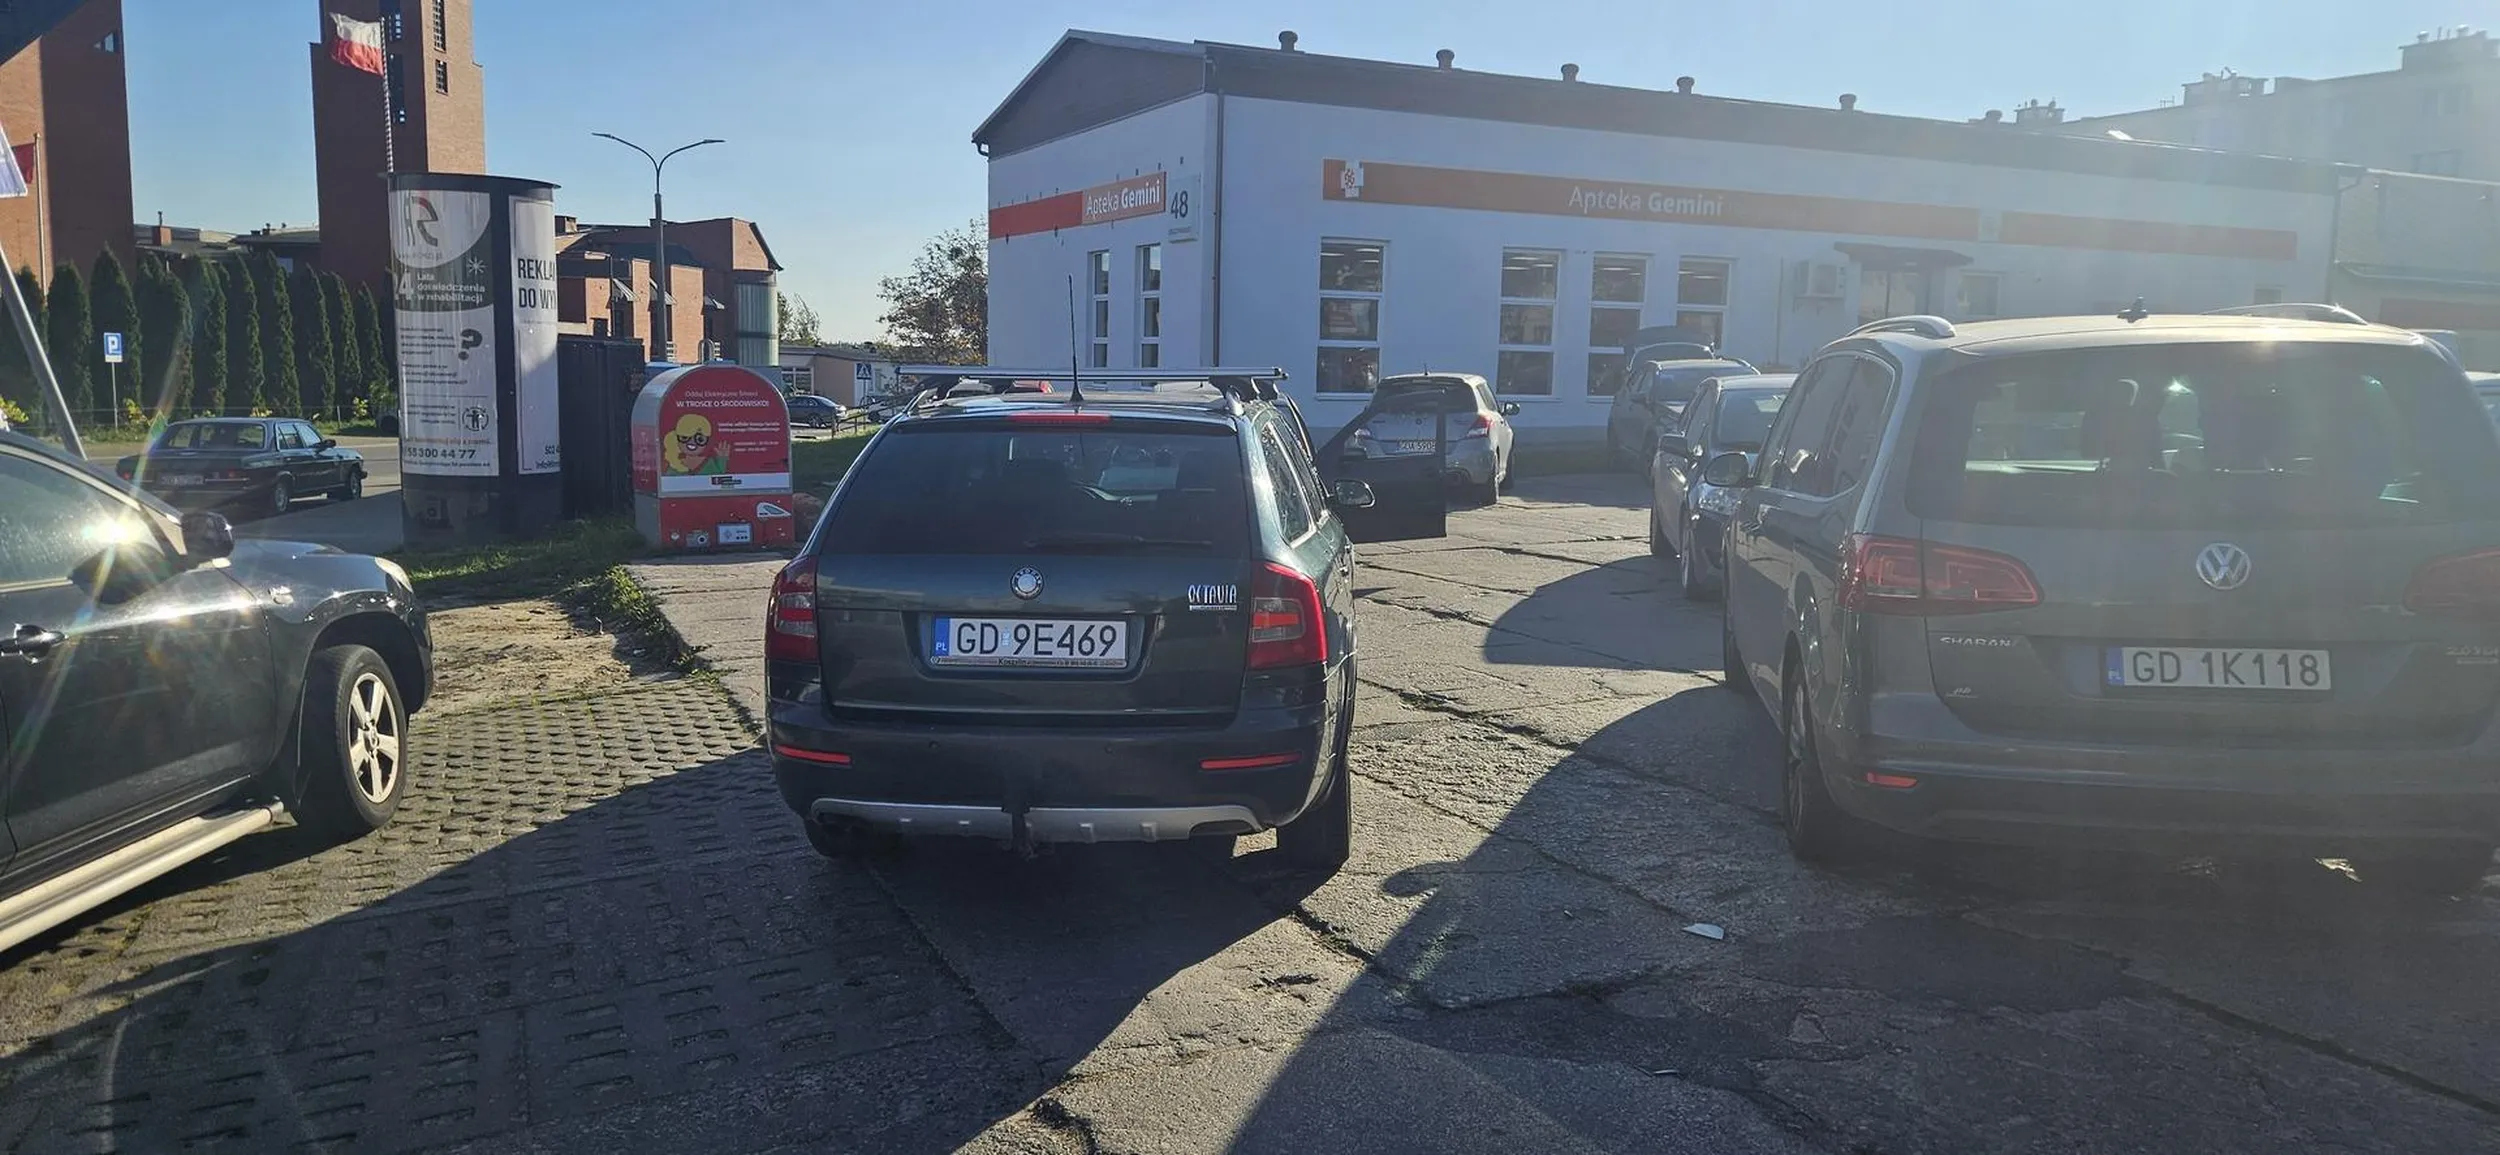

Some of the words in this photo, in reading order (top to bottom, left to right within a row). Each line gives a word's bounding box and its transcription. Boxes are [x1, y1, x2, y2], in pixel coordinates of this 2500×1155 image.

[1086, 192, 1120, 219] Apteka
[1120, 180, 1161, 211] Gemini
[1170, 190, 1189, 219] 48
[1568, 185, 1642, 214] Apteka
[1647, 192, 1724, 217] Gemini
[518, 287, 537, 309] DO
[1187, 584, 1238, 604] OCTAVIA
[935, 642, 948, 652] PL
[956, 622, 999, 655] GD
[1012, 623, 1117, 657] 9E469
[2107, 669, 2121, 681] PL
[2132, 651, 2182, 685] GD
[2200, 652, 2321, 687] 1K118
